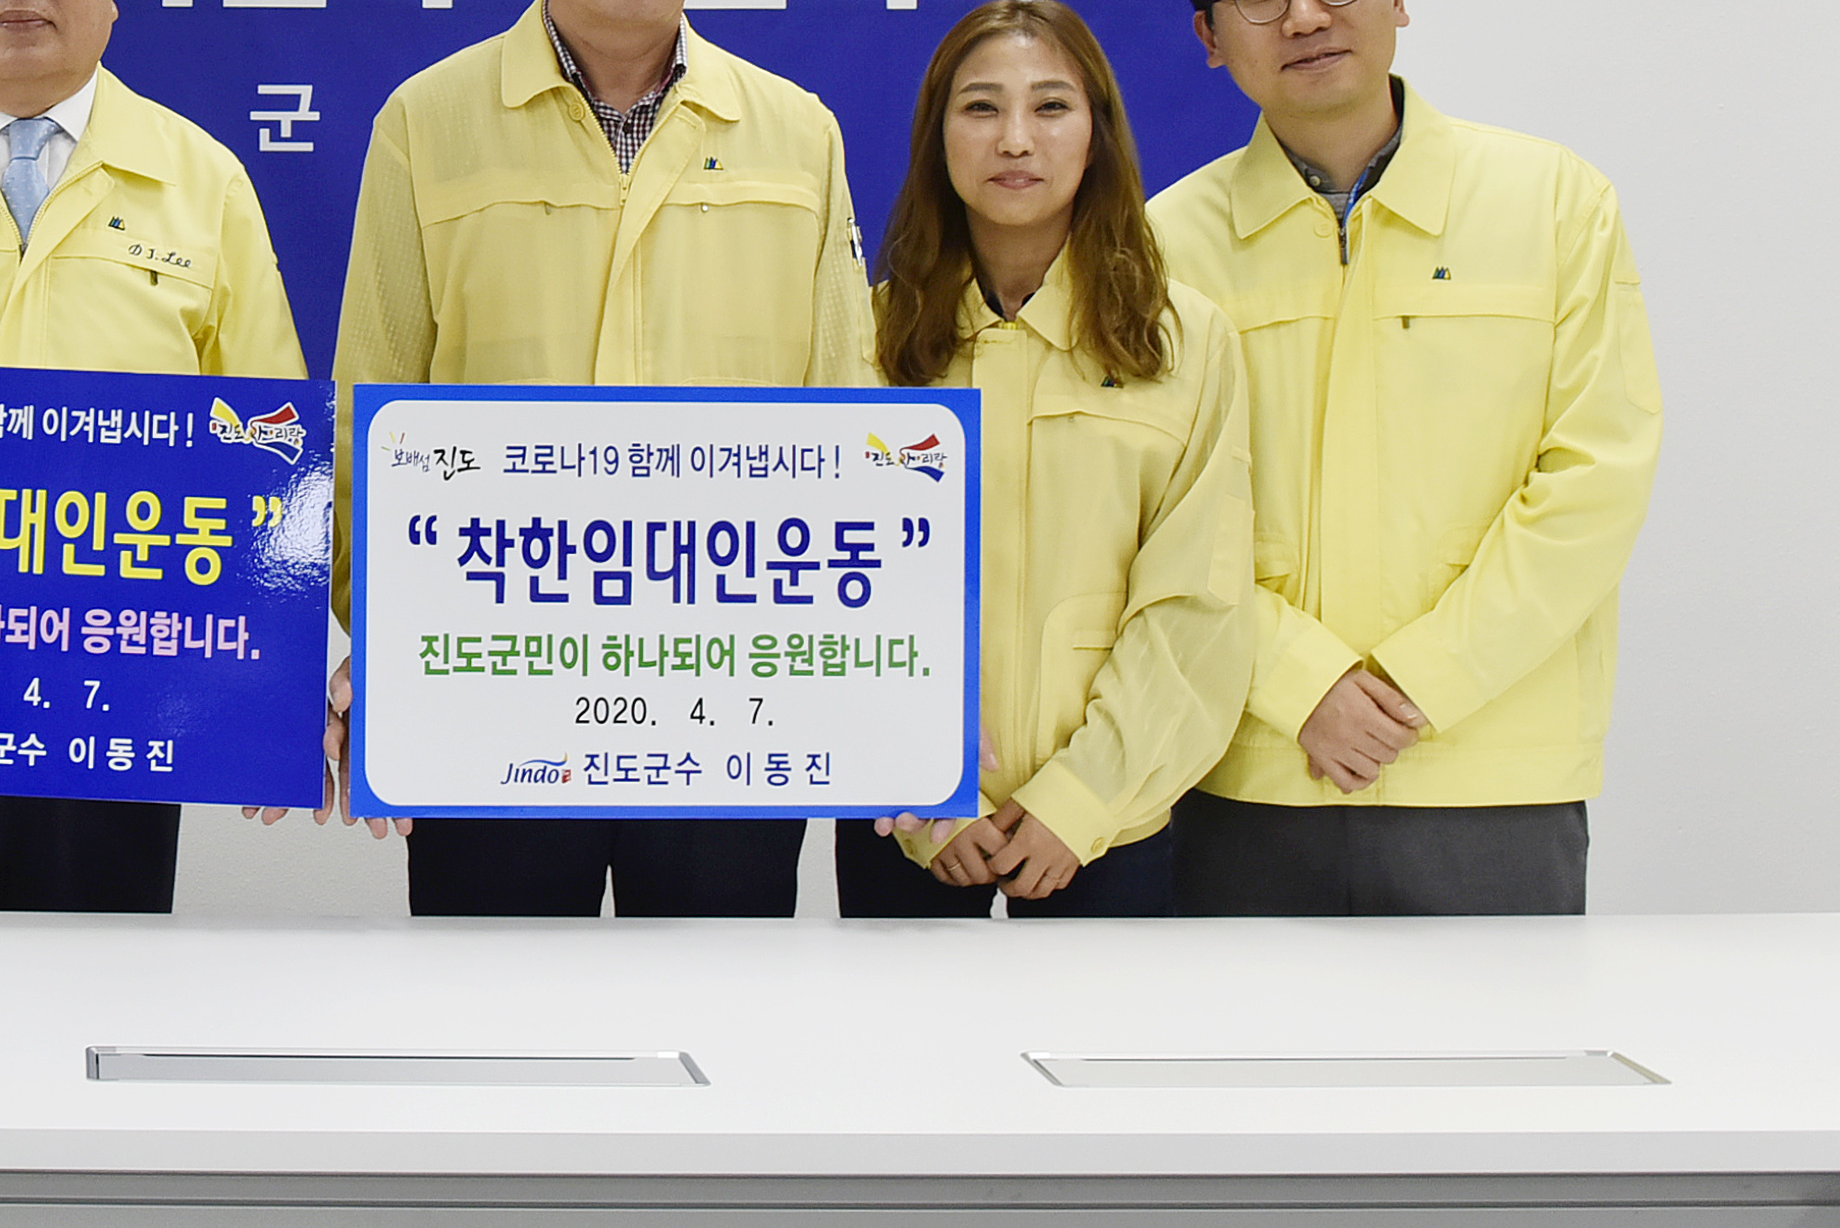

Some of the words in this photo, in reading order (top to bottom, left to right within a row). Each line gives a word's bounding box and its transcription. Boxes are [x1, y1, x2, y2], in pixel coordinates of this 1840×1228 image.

[250, 84, 320, 153] 군
[433, 446, 481, 480] 진도
[504, 443, 619, 477] 코로나19
[628, 443, 680, 478] 함께
[82, 609, 259, 659] 응원합니다.
[420, 634, 588, 676] 진도군민이
[602, 635, 734, 676] 하나되어
[749, 634, 929, 677] 응원합니다.
[24, 678, 49, 708] 4.
[85, 681, 109, 711] 7.
[576, 697, 656, 725] 2020.
[690, 698, 714, 726] 4.
[749, 698, 773, 726] 7.
[501, 762, 560, 784] Jindo
[584, 752, 702, 785] 진도군수
